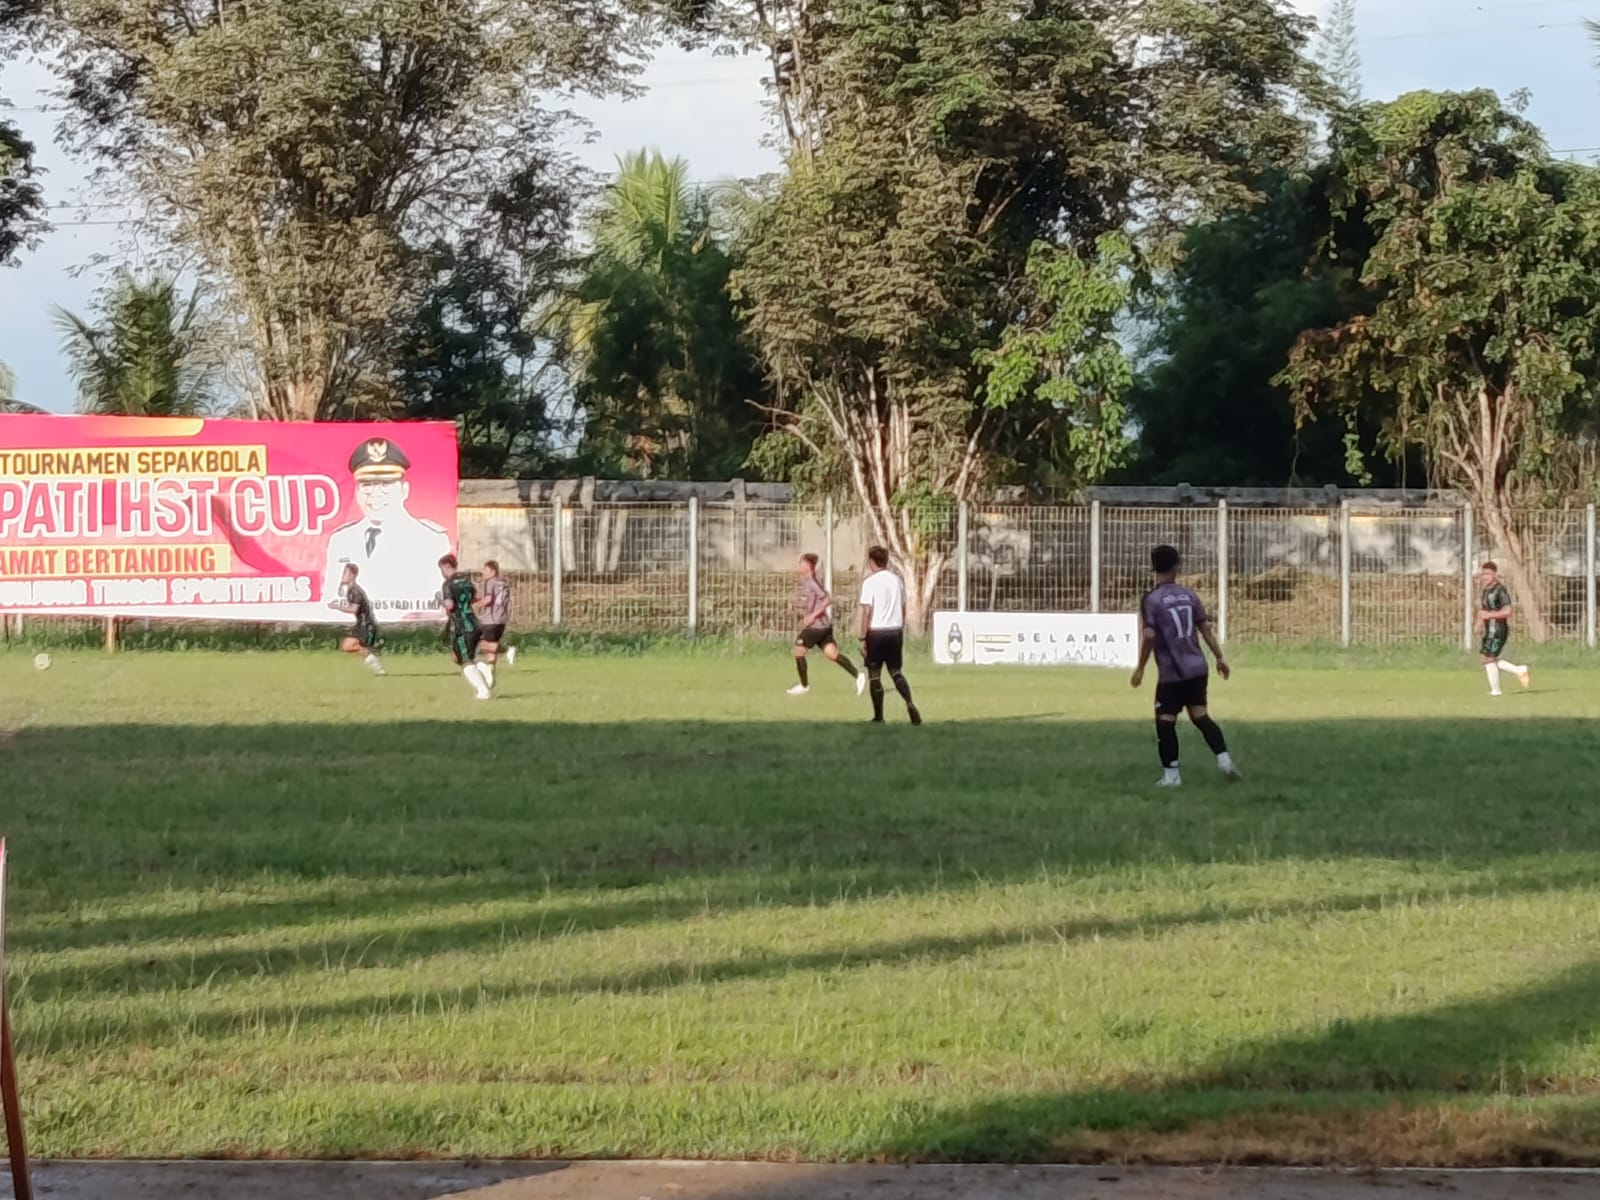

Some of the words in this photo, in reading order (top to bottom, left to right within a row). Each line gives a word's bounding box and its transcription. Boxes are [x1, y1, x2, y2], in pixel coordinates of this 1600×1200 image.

[0, 452, 130, 475] TOURNAMEN
[137, 450, 261, 474] SEPAKBOLA
[119, 479, 215, 535] HST
[232, 475, 338, 534] CUP
[65, 546, 216, 574] BERTANDING
[1167, 604, 1193, 640] 17
[1017, 632, 1132, 644] SELAMAT
